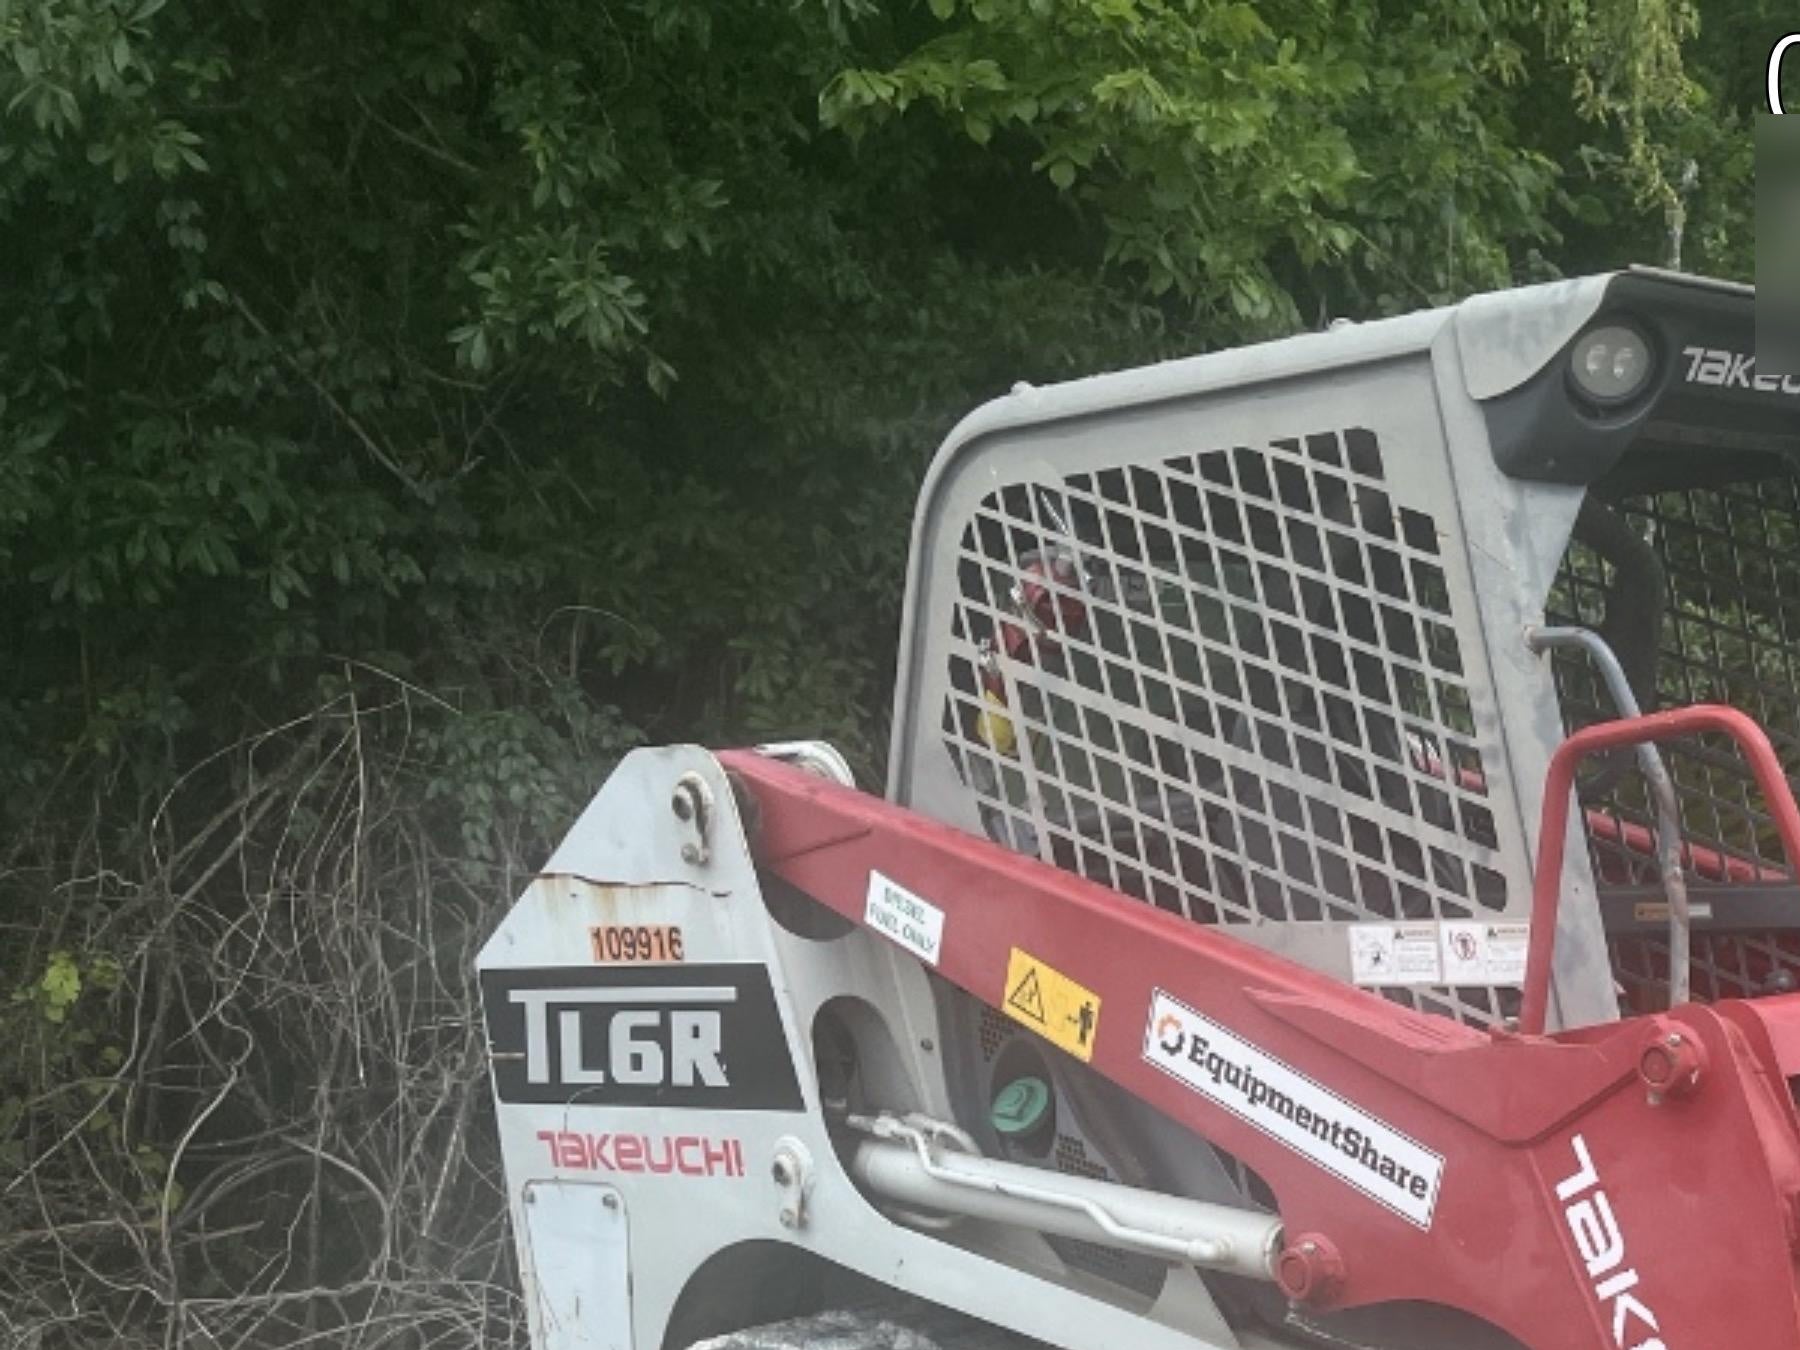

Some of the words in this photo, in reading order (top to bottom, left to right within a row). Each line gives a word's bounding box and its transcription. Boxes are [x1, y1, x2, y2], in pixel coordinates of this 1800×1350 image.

[591, 925, 685, 961] 109916
[508, 985, 738, 1088] TL6R
[536, 1129, 745, 1178] TAKEUCHI
[1187, 1033, 1430, 1200] EquipmentShare
